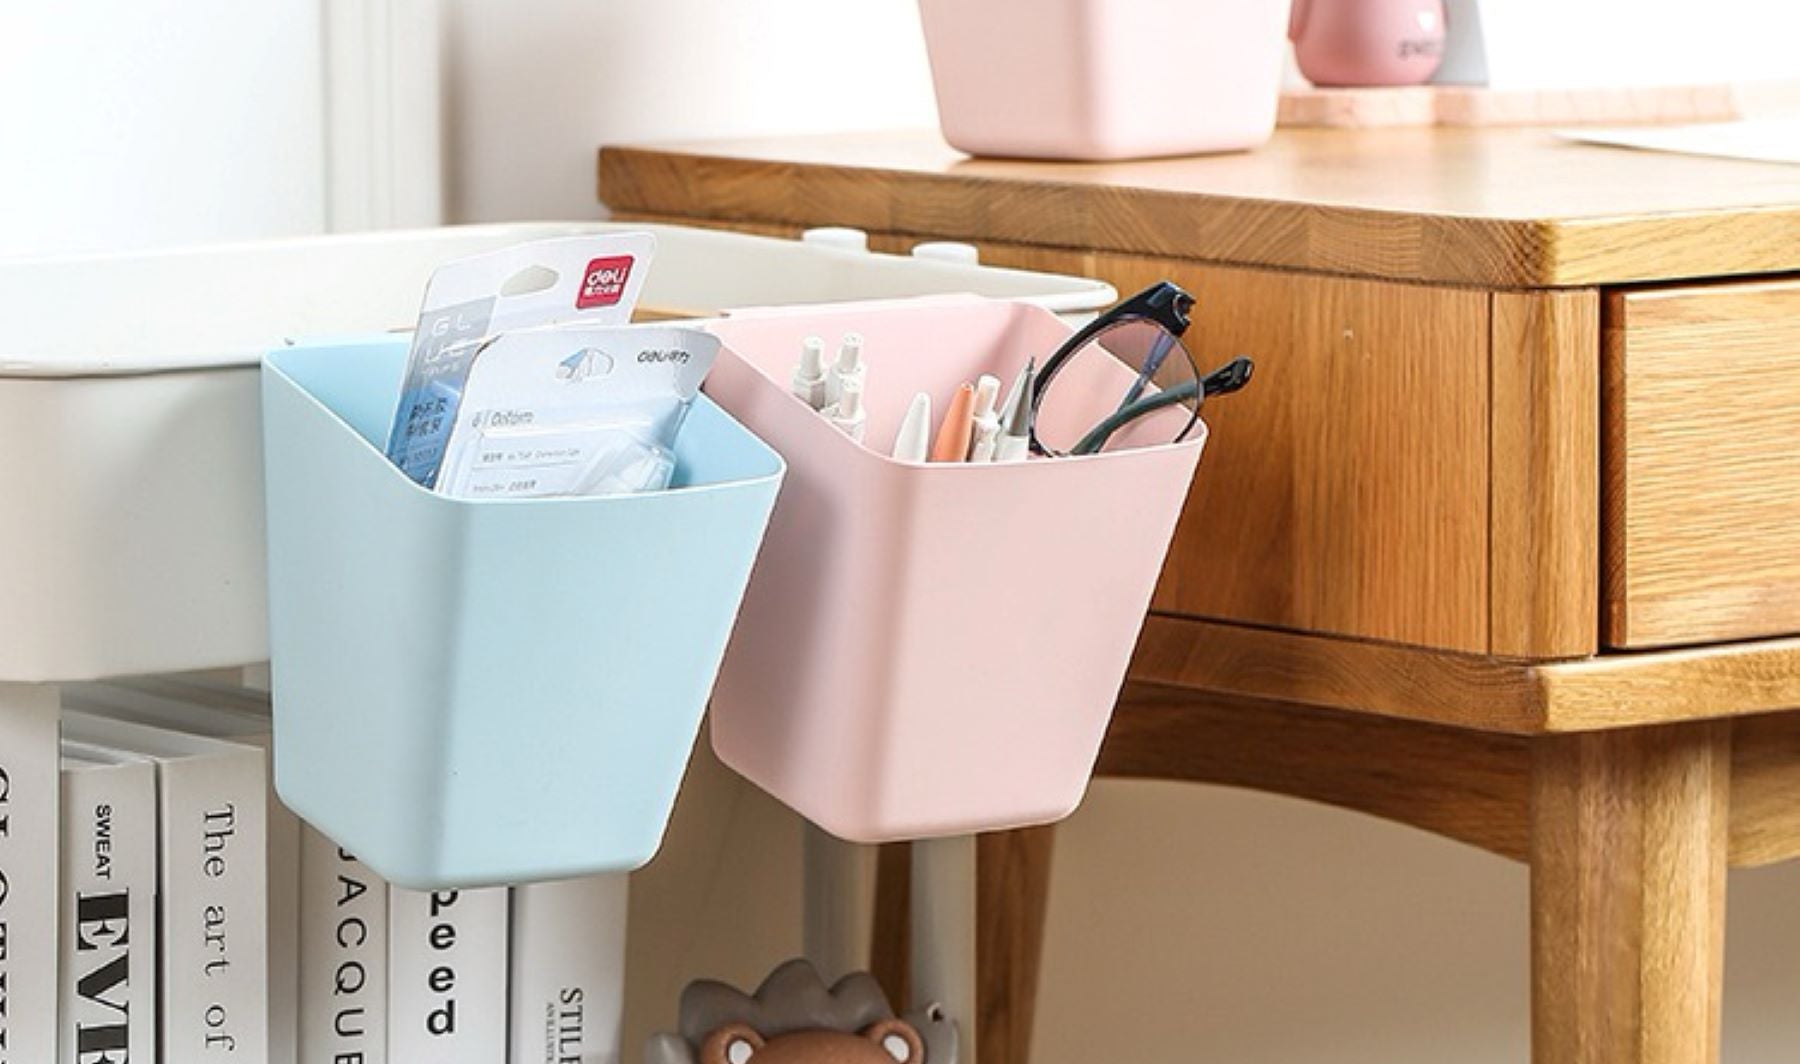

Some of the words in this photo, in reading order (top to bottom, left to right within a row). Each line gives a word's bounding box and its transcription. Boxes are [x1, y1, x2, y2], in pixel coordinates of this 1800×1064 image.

[95, 804, 112, 881] SWEAT
[203, 803, 235, 877] The
[203, 905, 231, 977] art
[205, 1004, 236, 1052] of
